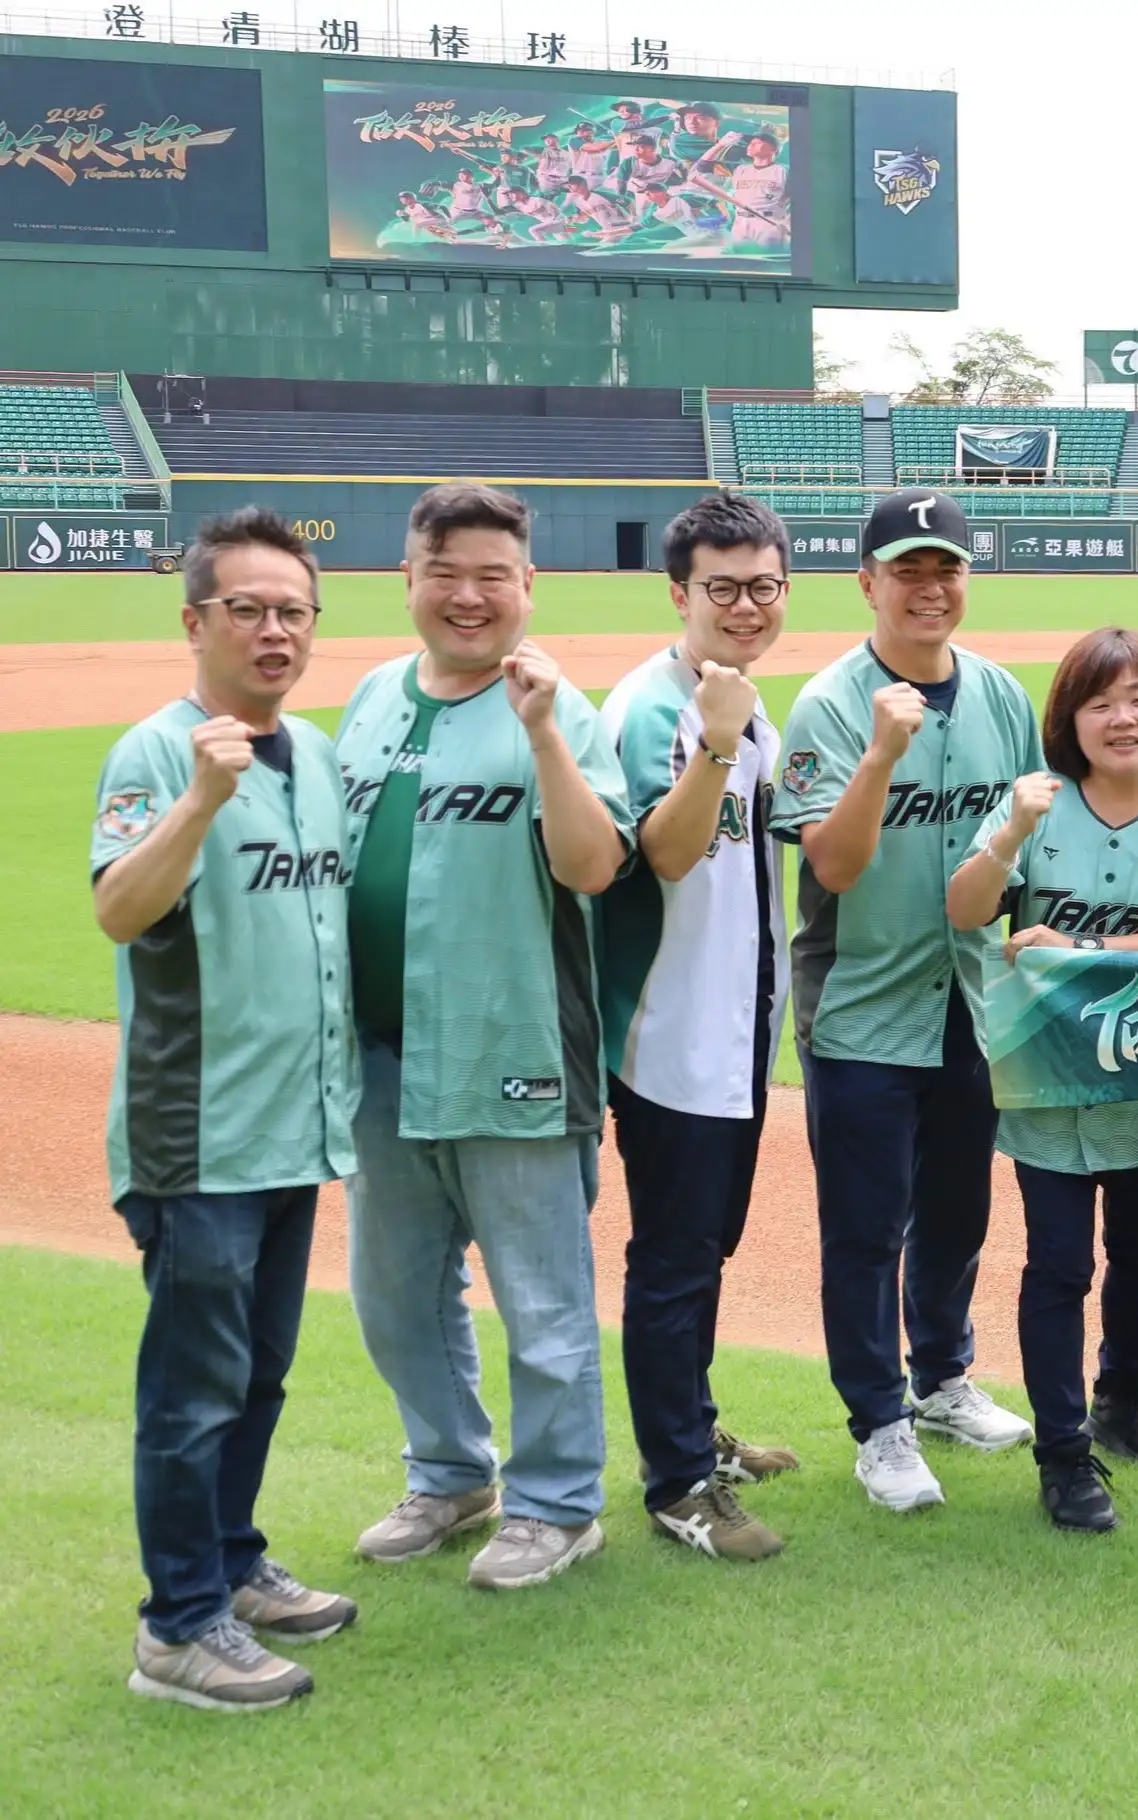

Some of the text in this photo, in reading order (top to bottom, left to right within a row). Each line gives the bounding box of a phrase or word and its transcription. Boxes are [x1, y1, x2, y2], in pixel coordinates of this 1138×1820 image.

[105, 4, 670, 71] 澄清湖棒球場
[45, 103, 107, 124] 2026
[415, 100, 457, 113] 2026
[83, 167, 187, 180] Together We Fly
[894, 175, 918, 191] TSG
[884, 186, 930, 206] HAWKS
[908, 496, 937, 529] T
[67, 528, 155, 549] 加捷生醫
[291, 520, 335, 541] 400
[793, 537, 856, 554] 台鋼集團
[1044, 538, 1124, 557] 亞果遊艇
[67, 551, 125, 562] JIAJIE
[971, 553, 993, 561] OUP
